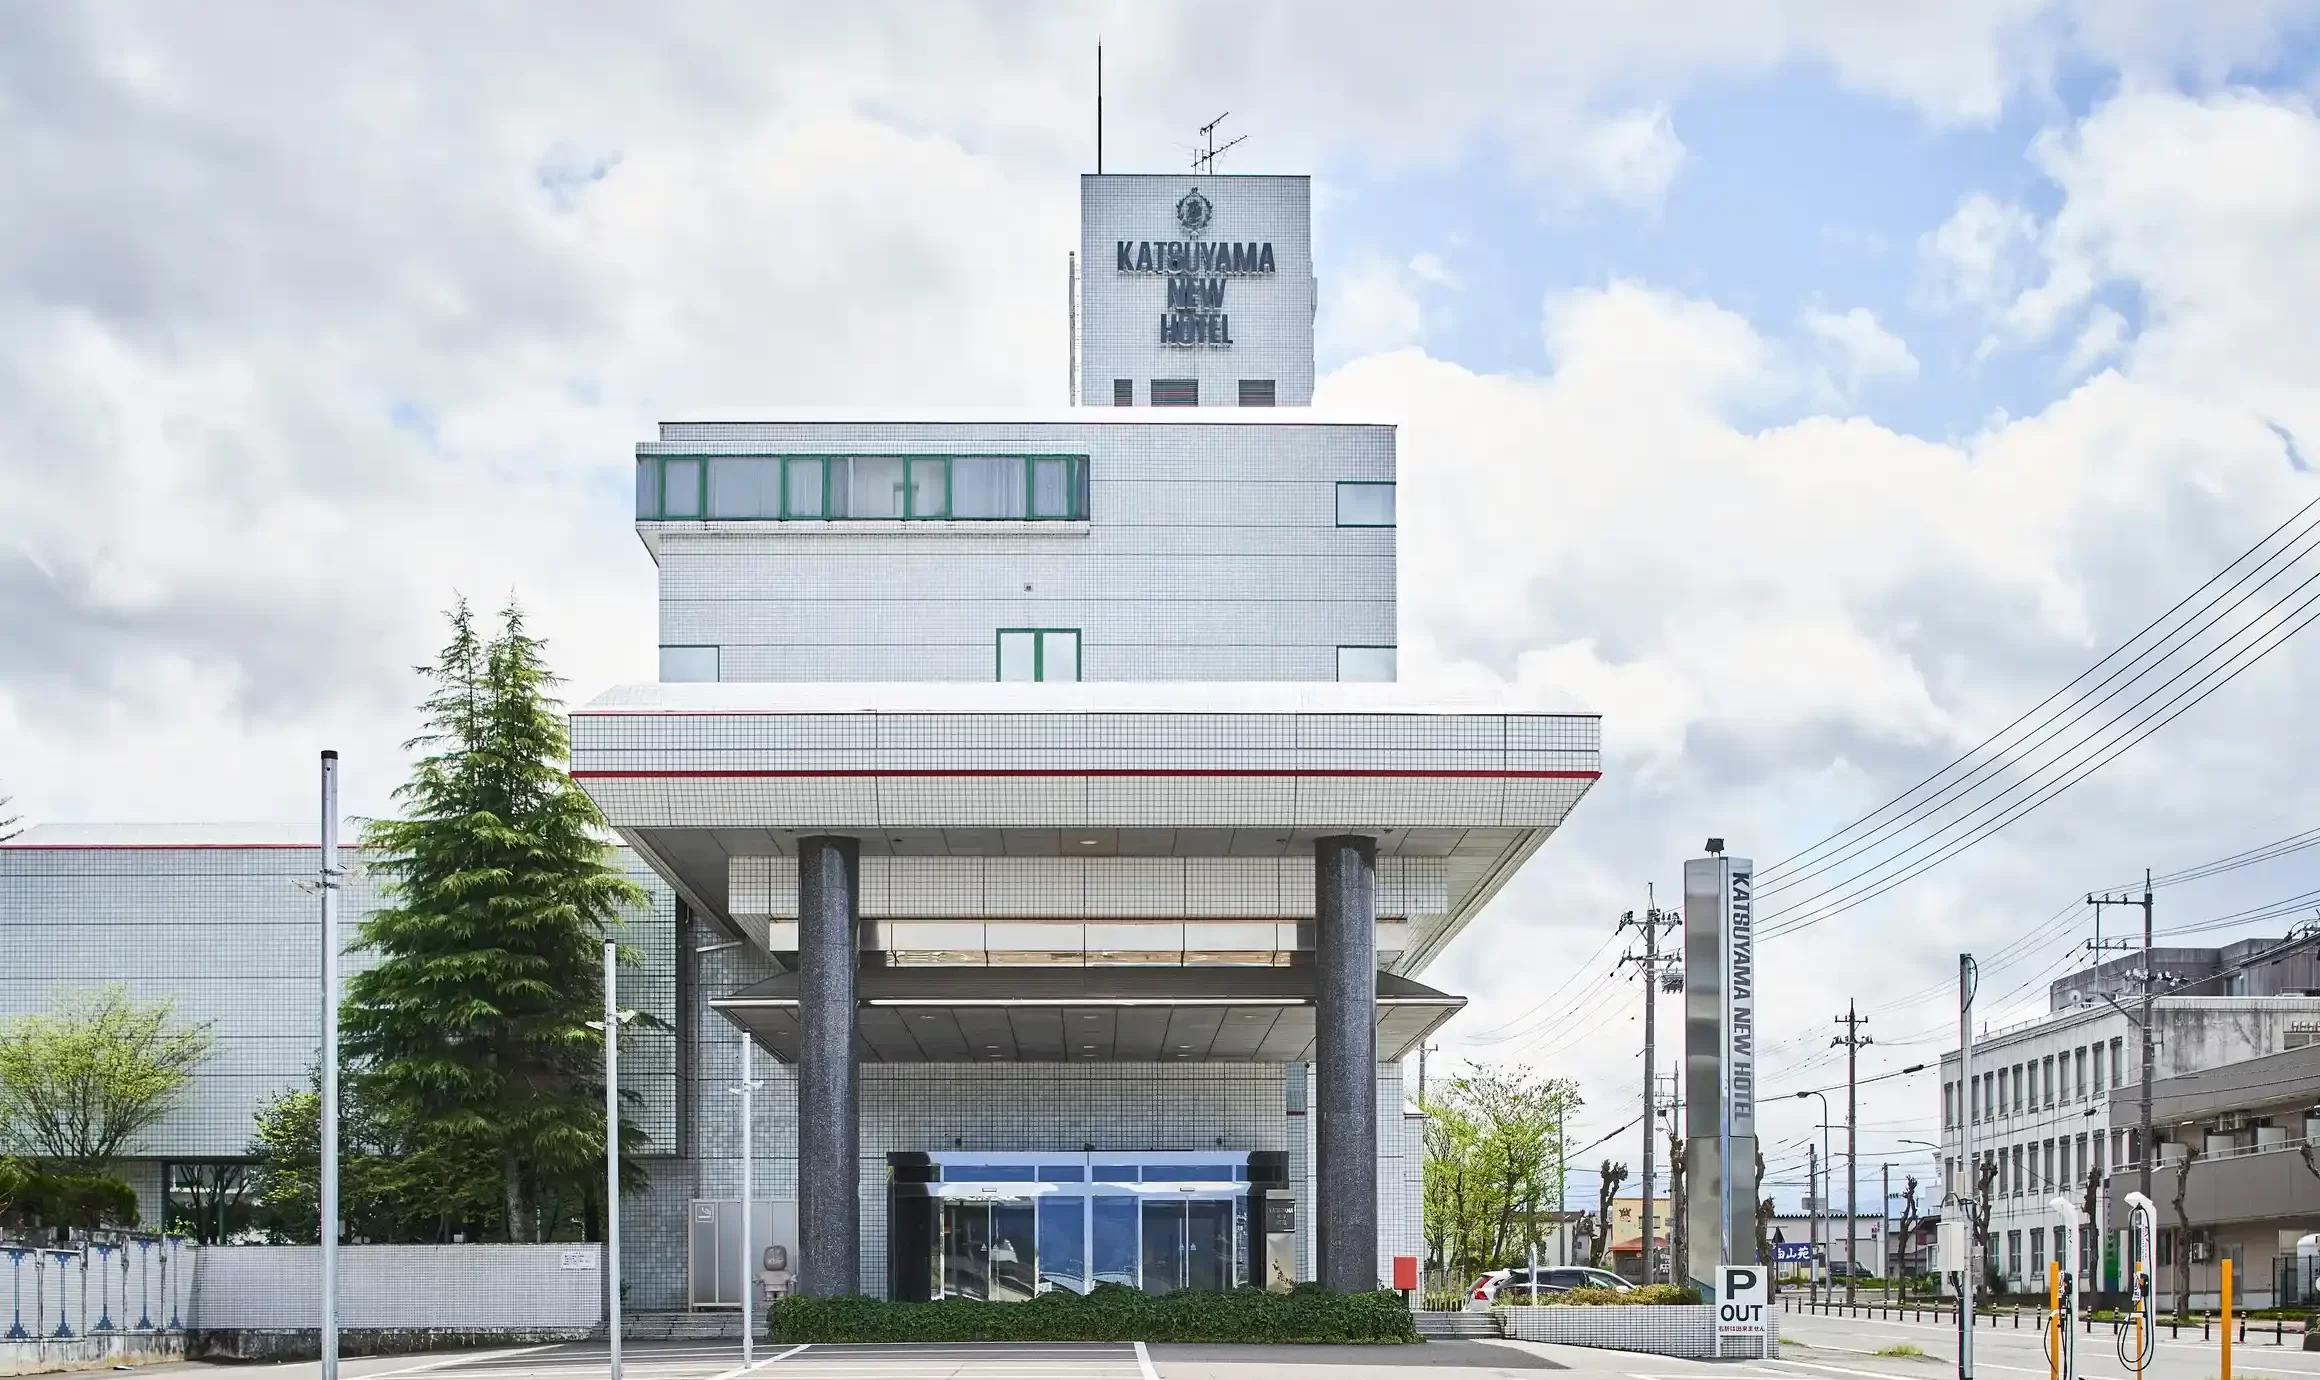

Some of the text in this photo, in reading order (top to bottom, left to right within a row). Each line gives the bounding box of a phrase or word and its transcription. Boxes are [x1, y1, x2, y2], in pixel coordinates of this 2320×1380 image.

[1117, 241, 1276, 273] KATSUYAMA
[1167, 277, 1227, 309] NEW
[1160, 313, 1234, 345] HOTEL
[1732, 872, 1752, 1122] KATSUYAMA NEW HOTEL
[1726, 1269, 1757, 1300] P
[1720, 1304, 1763, 1322] OUT
